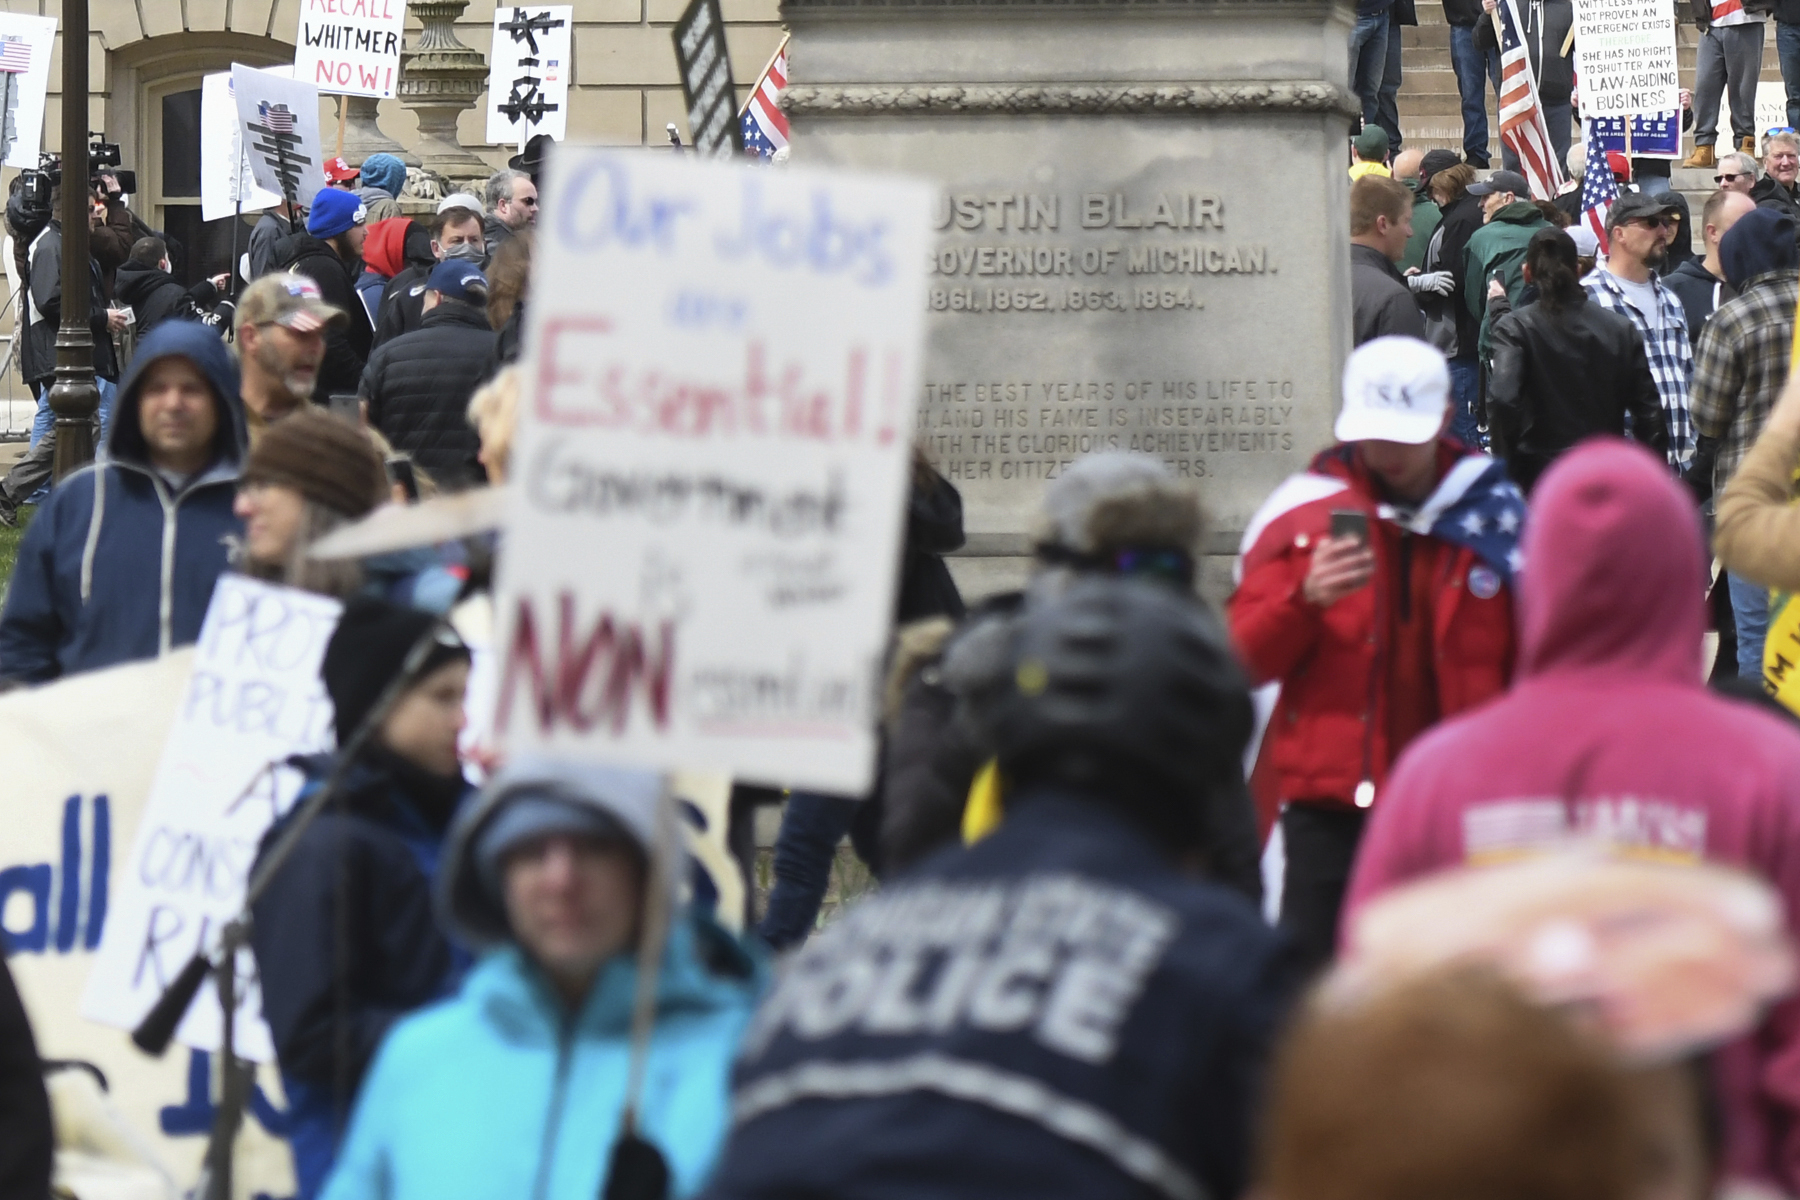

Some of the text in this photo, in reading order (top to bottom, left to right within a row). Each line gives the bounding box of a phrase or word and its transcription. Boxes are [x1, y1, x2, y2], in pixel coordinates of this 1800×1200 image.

[1579, 8, 1657, 22] NOT PROVEN AN
[1580, 19, 1671, 36] EMERGENCY EXISTS
[305, 22, 398, 57] WHITMER
[1582, 46, 1672, 62] SHE HAS NO RIGHT
[315, 59, 392, 97] NOW!
[1584, 65, 1596, 75] TO
[1597, 60, 1643, 74] SHUTTER
[1589, 71, 1677, 92] LAW-ABIDING
[1596, 89, 1667, 111] BUSINESS
[1597, 121, 1667, 132] PENCE
[930, 192, 1224, 230] USTIN BLAIR
[557, 155, 898, 290] Our Jobs
[1081, 247, 1120, 274] OF
[925, 381, 1293, 402] THE BEST YEARS OF HIS LIFE TO
[994, 409, 1028, 428] HIS
[1040, 408, 1098, 428] FAME
[1108, 408, 1128, 427] IS
[1139, 406, 1292, 427] INSEPARABLY
[924, 433, 1293, 454] ITH THE GLORIOUS ACHIEVEMENTS
[949, 460, 992, 480] HER
[743, 945, 1142, 1066] POLICE
